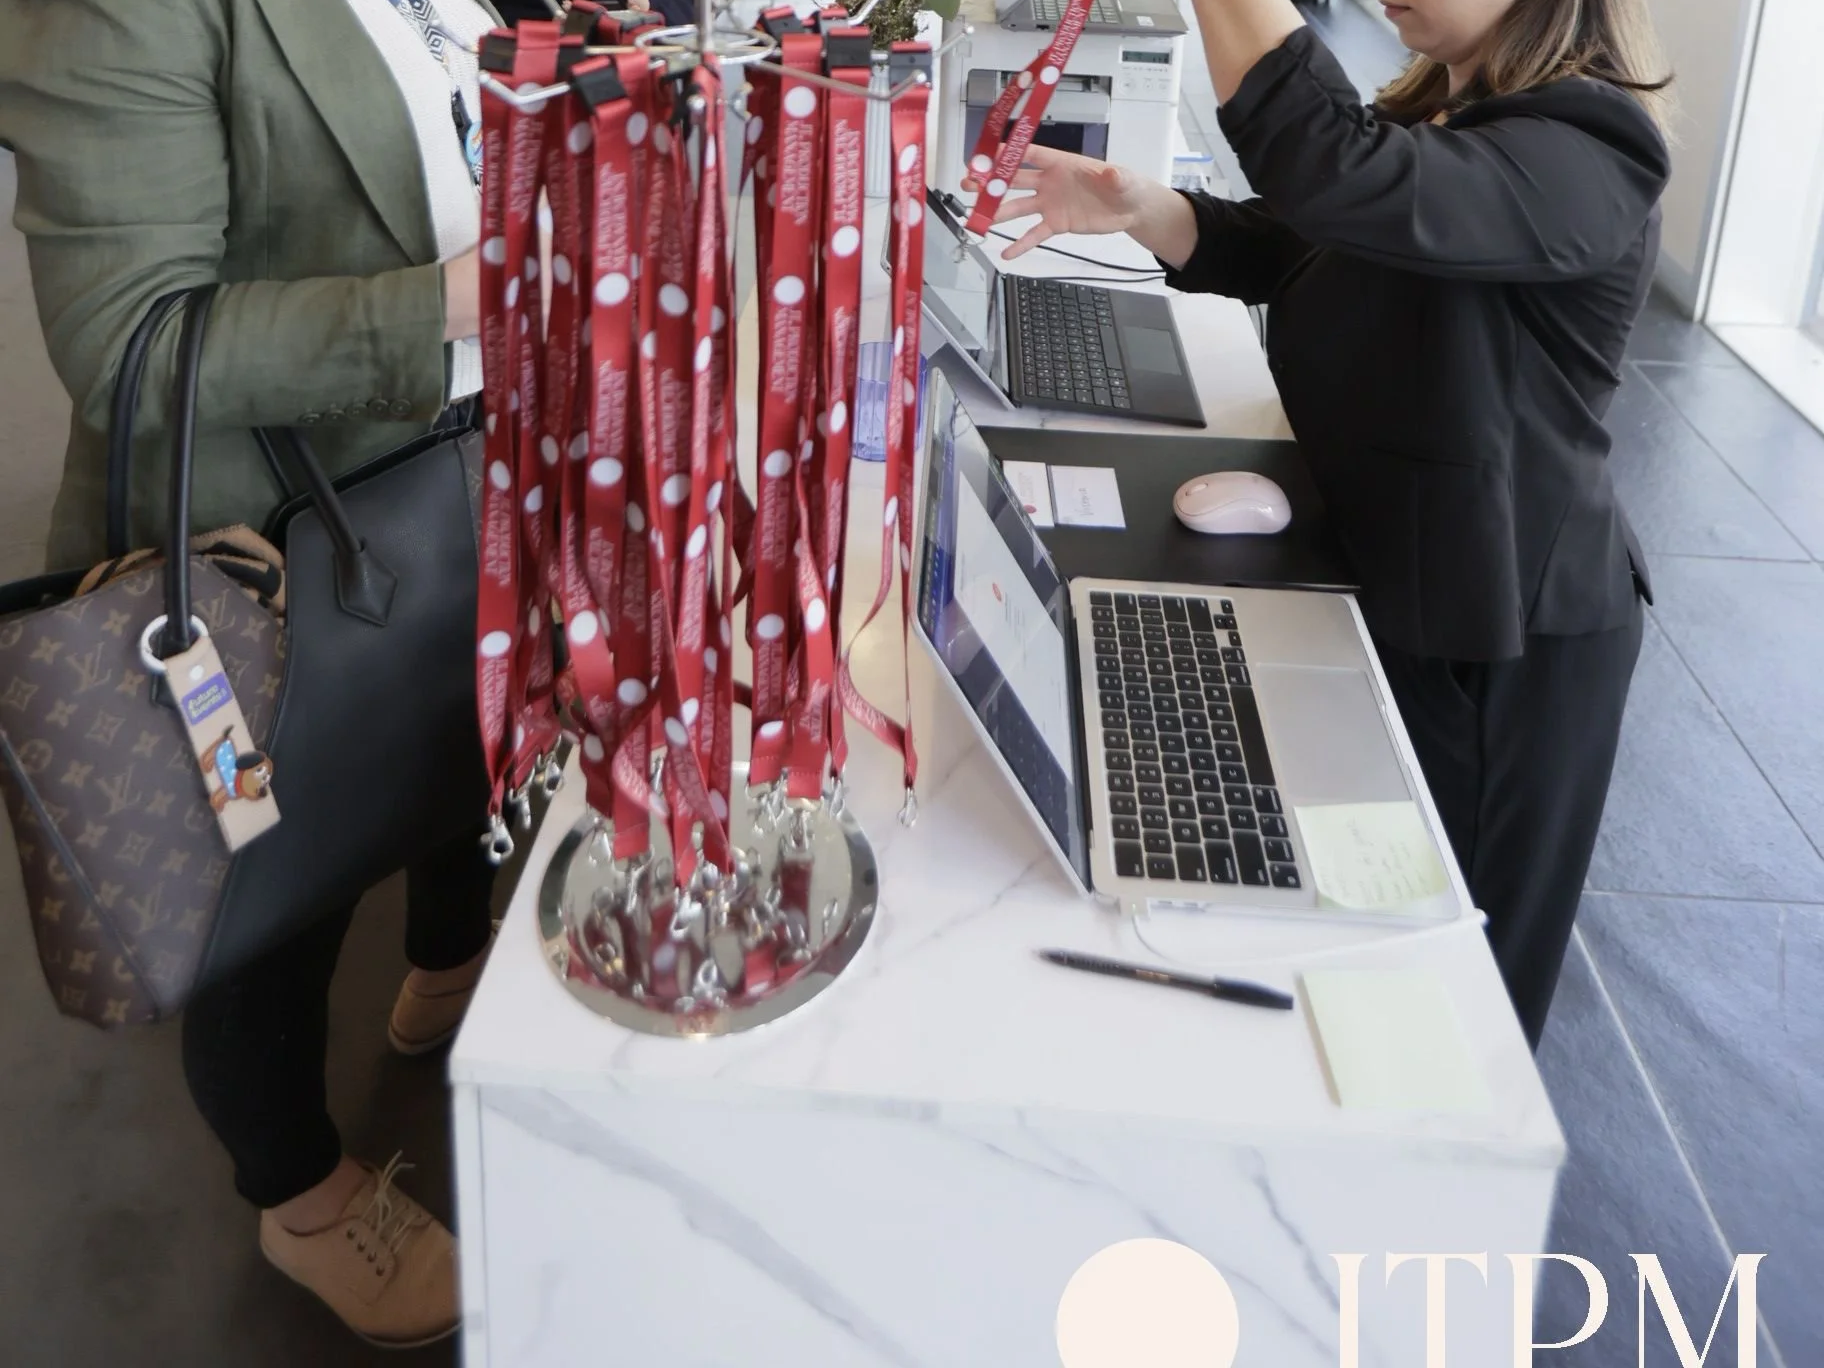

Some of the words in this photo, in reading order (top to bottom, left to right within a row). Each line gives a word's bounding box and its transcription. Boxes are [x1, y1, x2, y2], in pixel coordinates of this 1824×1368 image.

[1052, 8, 1087, 65] MANAGEMENT
[781, 120, 800, 212] MANAGEMENT
[795, 140, 812, 225] PRODUCTION
